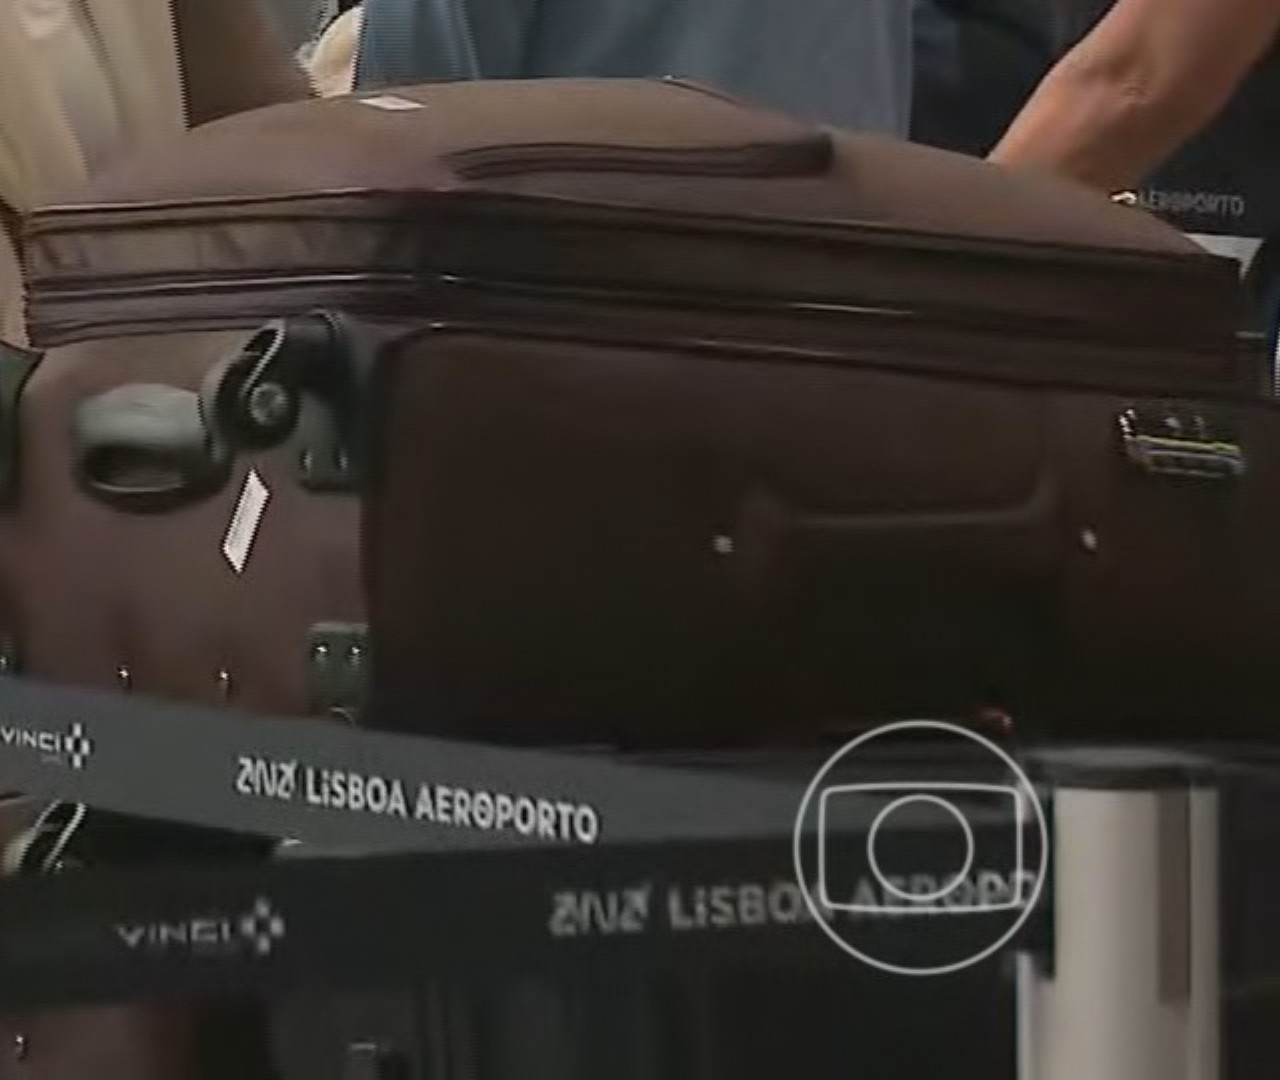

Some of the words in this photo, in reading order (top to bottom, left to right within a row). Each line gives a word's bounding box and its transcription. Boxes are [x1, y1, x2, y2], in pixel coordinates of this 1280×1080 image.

[0, 725, 60, 752] VINCI
[415, 782, 598, 844] AEROPORTO
[114, 918, 230, 950] VINCI
